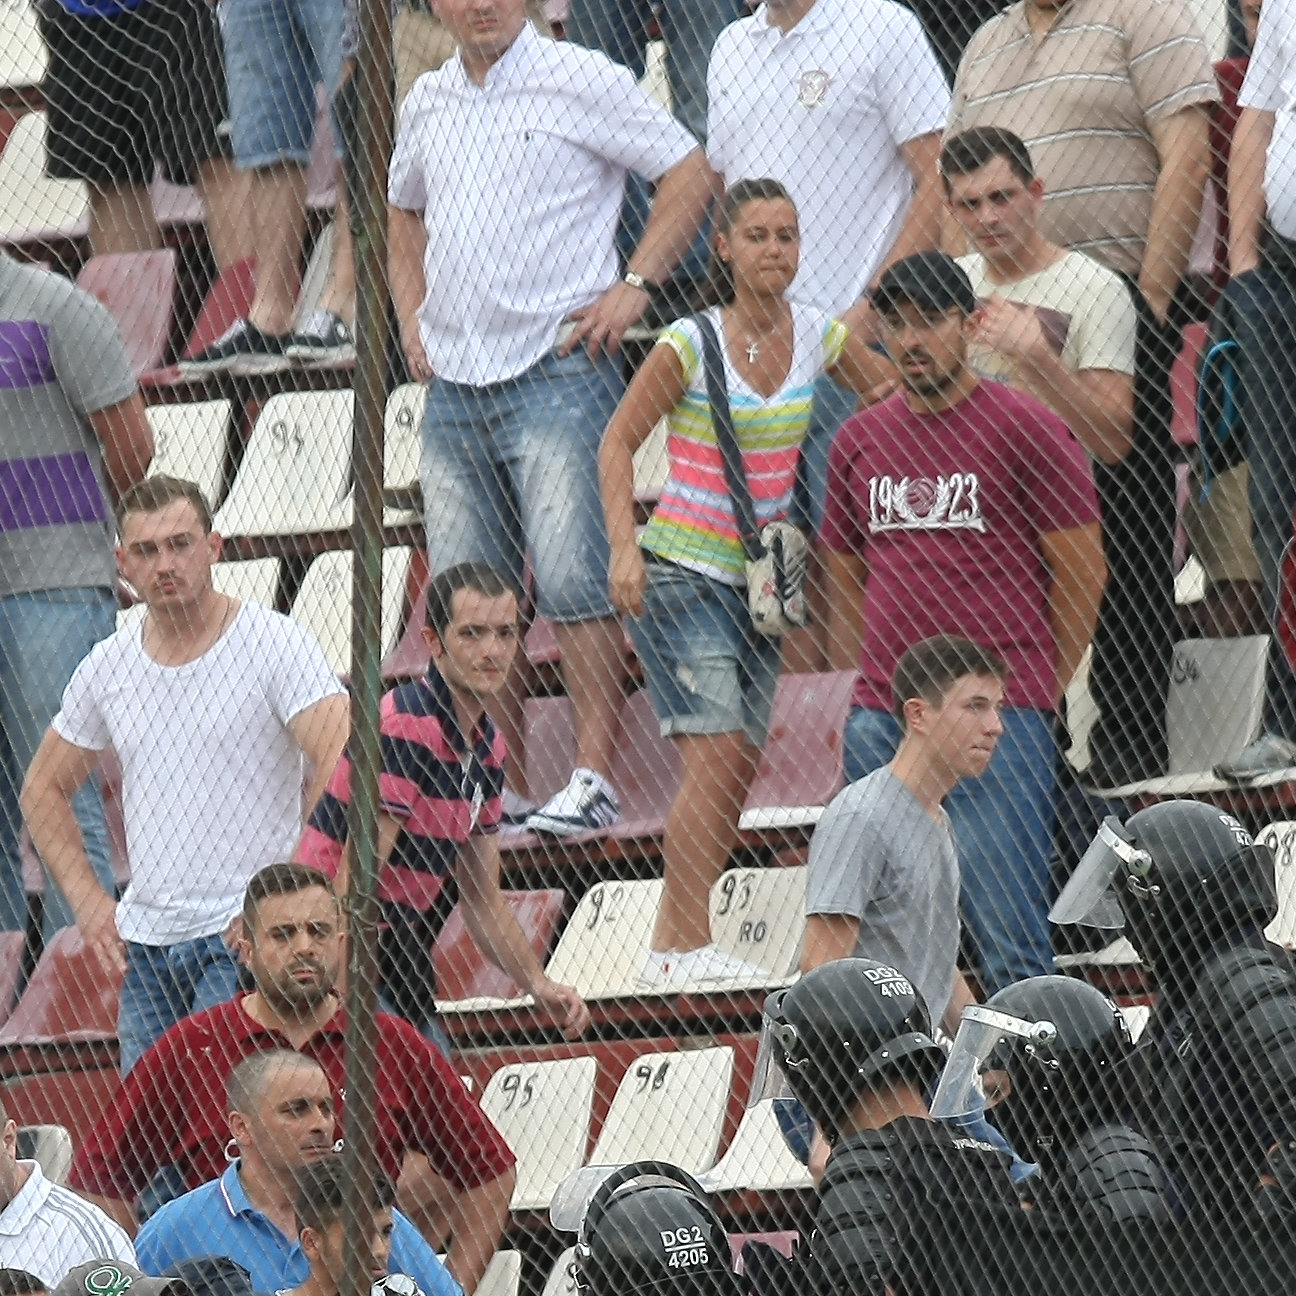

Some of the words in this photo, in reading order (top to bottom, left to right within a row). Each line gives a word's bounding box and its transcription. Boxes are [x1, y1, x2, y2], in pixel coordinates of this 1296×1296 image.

[868, 472, 894, 521] 19
[949, 472, 979, 521] 23
[861, 966, 903, 984] DG2
[503, 1071, 538, 1112] 95
[660, 1225, 705, 1250] DG2
[667, 1248, 709, 1270] 4205
